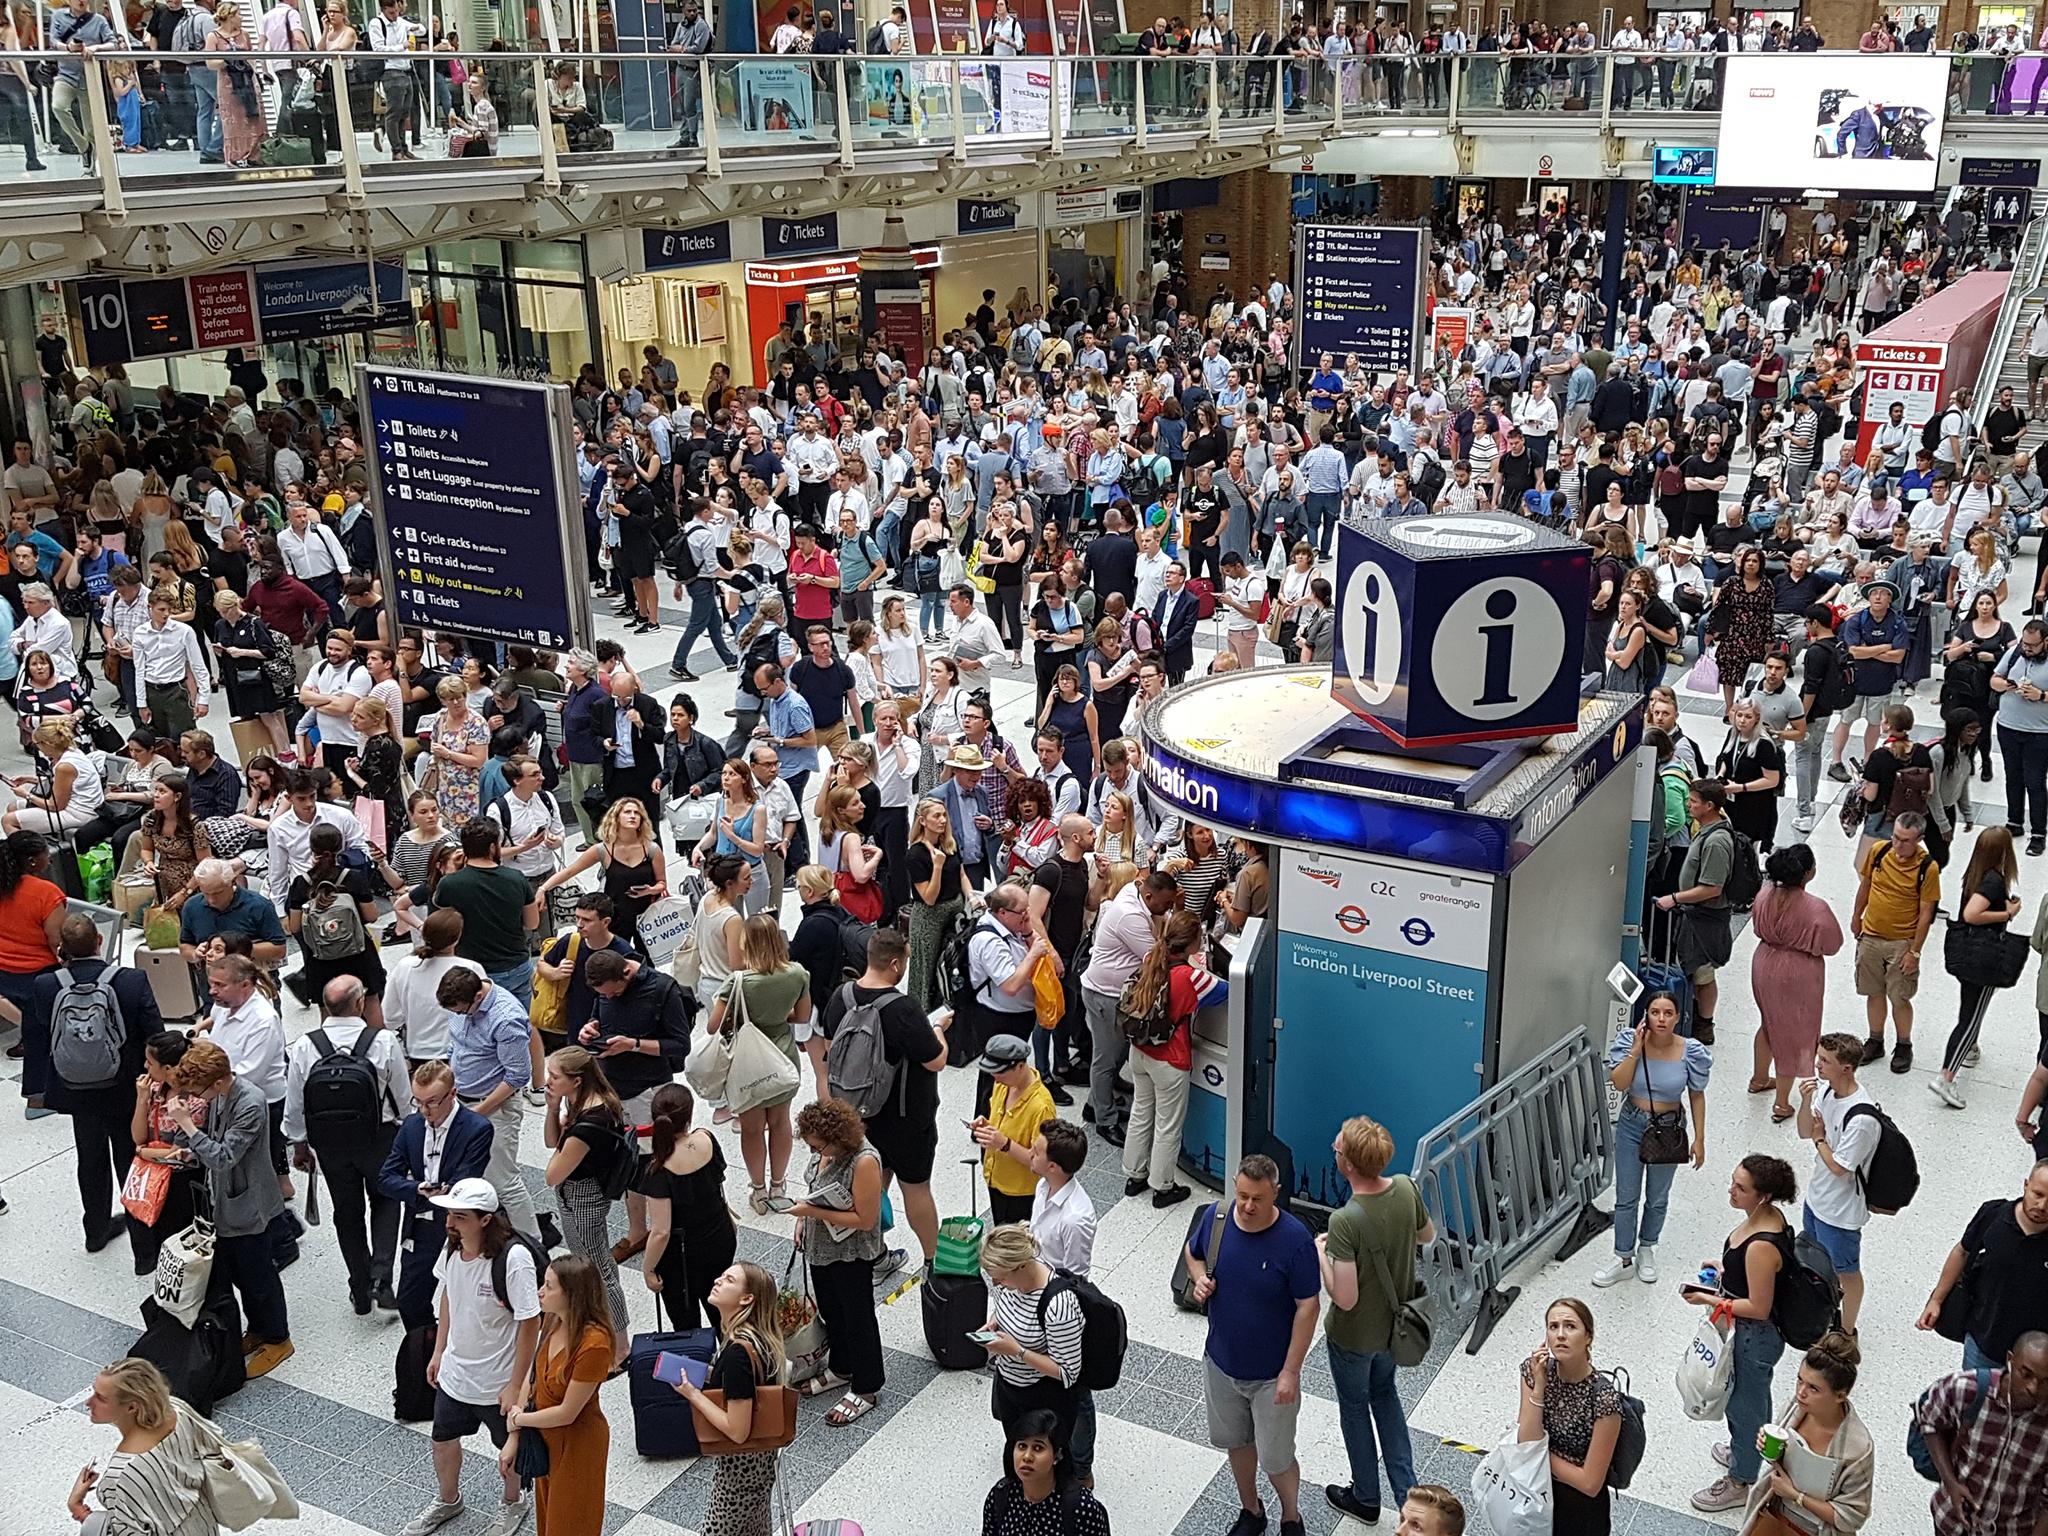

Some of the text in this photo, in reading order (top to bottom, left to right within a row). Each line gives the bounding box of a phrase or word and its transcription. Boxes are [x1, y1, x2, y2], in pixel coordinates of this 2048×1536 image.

[982, 206, 1005, 220] Tickets
[794, 224, 825, 240] Tickets
[680, 236, 716, 252] Tickets
[1349, 256, 1376, 264] reception
[751, 271, 772, 280] Tickets
[826, 266, 841, 274] Tickets
[197, 282, 243, 294] Train doors
[264, 280, 303, 292] Welcome to
[199, 293, 237, 306] will close
[265, 282, 382, 307] London Liverpool Stret
[1324, 290, 1352, 299] Transport
[82, 292, 122, 330] 10
[201, 304, 247, 318] 30 seconds
[1324, 302, 1336, 310] Way
[202, 317, 230, 330] before
[204, 327, 244, 341] departure
[1872, 348, 1916, 361] Tickets
[401, 380, 417, 393] TfL
[418, 383, 435, 395] Rail
[437, 388, 459, 397] Platforms
[406, 424, 437, 438] Toilets
[409, 446, 440, 460] Toilets
[466, 457, 488, 467] babycare
[412, 467, 431, 480] Left
[433, 469, 472, 486] Luggage
[484, 482, 504, 491] property
[512, 486, 532, 494] platform
[416, 489, 448, 504] Station
[450, 494, 494, 511] reception
[503, 506, 523, 515] platform
[421, 531, 445, 546] Cycle
[447, 534, 470, 549] racks
[479, 544, 499, 554] platform
[424, 553, 443, 566] First
[445, 556, 458, 568] aid
[467, 563, 487, 573] platform
[425, 573, 444, 588] Way
[447, 578, 462, 589] out
[428, 594, 460, 608] Tickets
[453, 622, 482, 633] Underground
[518, 629, 534, 641] Lift
[1530, 758, 1597, 840] information
[1370, 880, 1397, 897] c2c
[1420, 891, 1480, 909] greateranglia
[654, 911, 679, 927] time
[1293, 942, 1328, 957] Welcome
[1293, 952, 1475, 1002] London Liverpool Street
